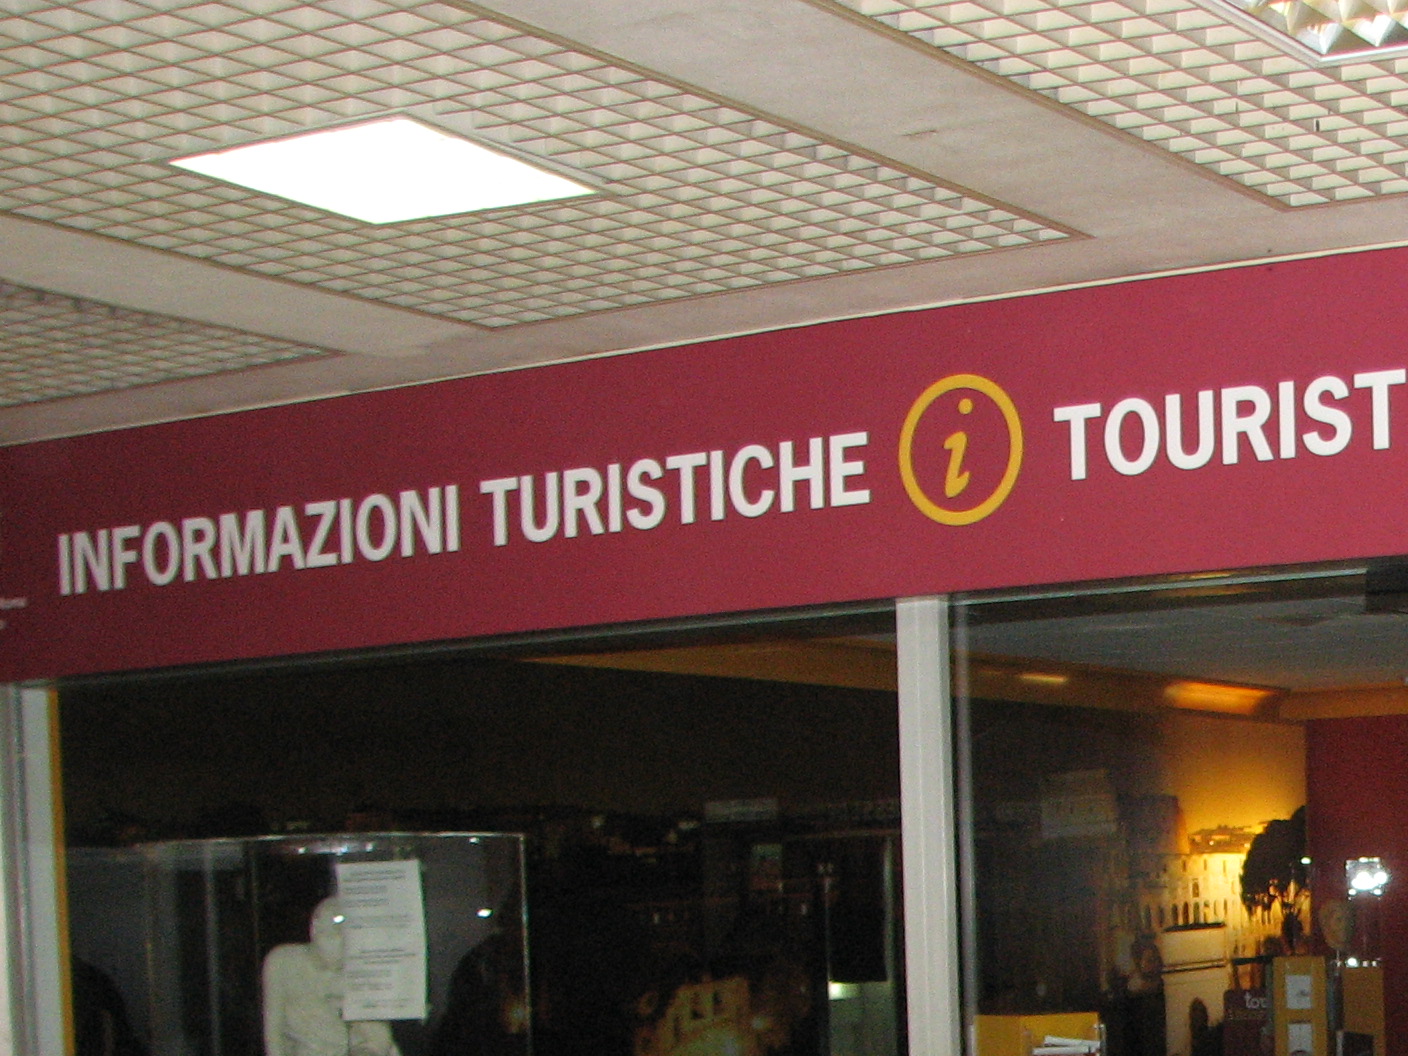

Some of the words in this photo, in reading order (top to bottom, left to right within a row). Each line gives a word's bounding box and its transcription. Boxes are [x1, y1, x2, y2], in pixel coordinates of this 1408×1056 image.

[1053, 369, 1406, 481] TOURIST
[58, 485, 460, 596] INFORMAZIONI
[480, 432, 870, 546] TURISTICHE
